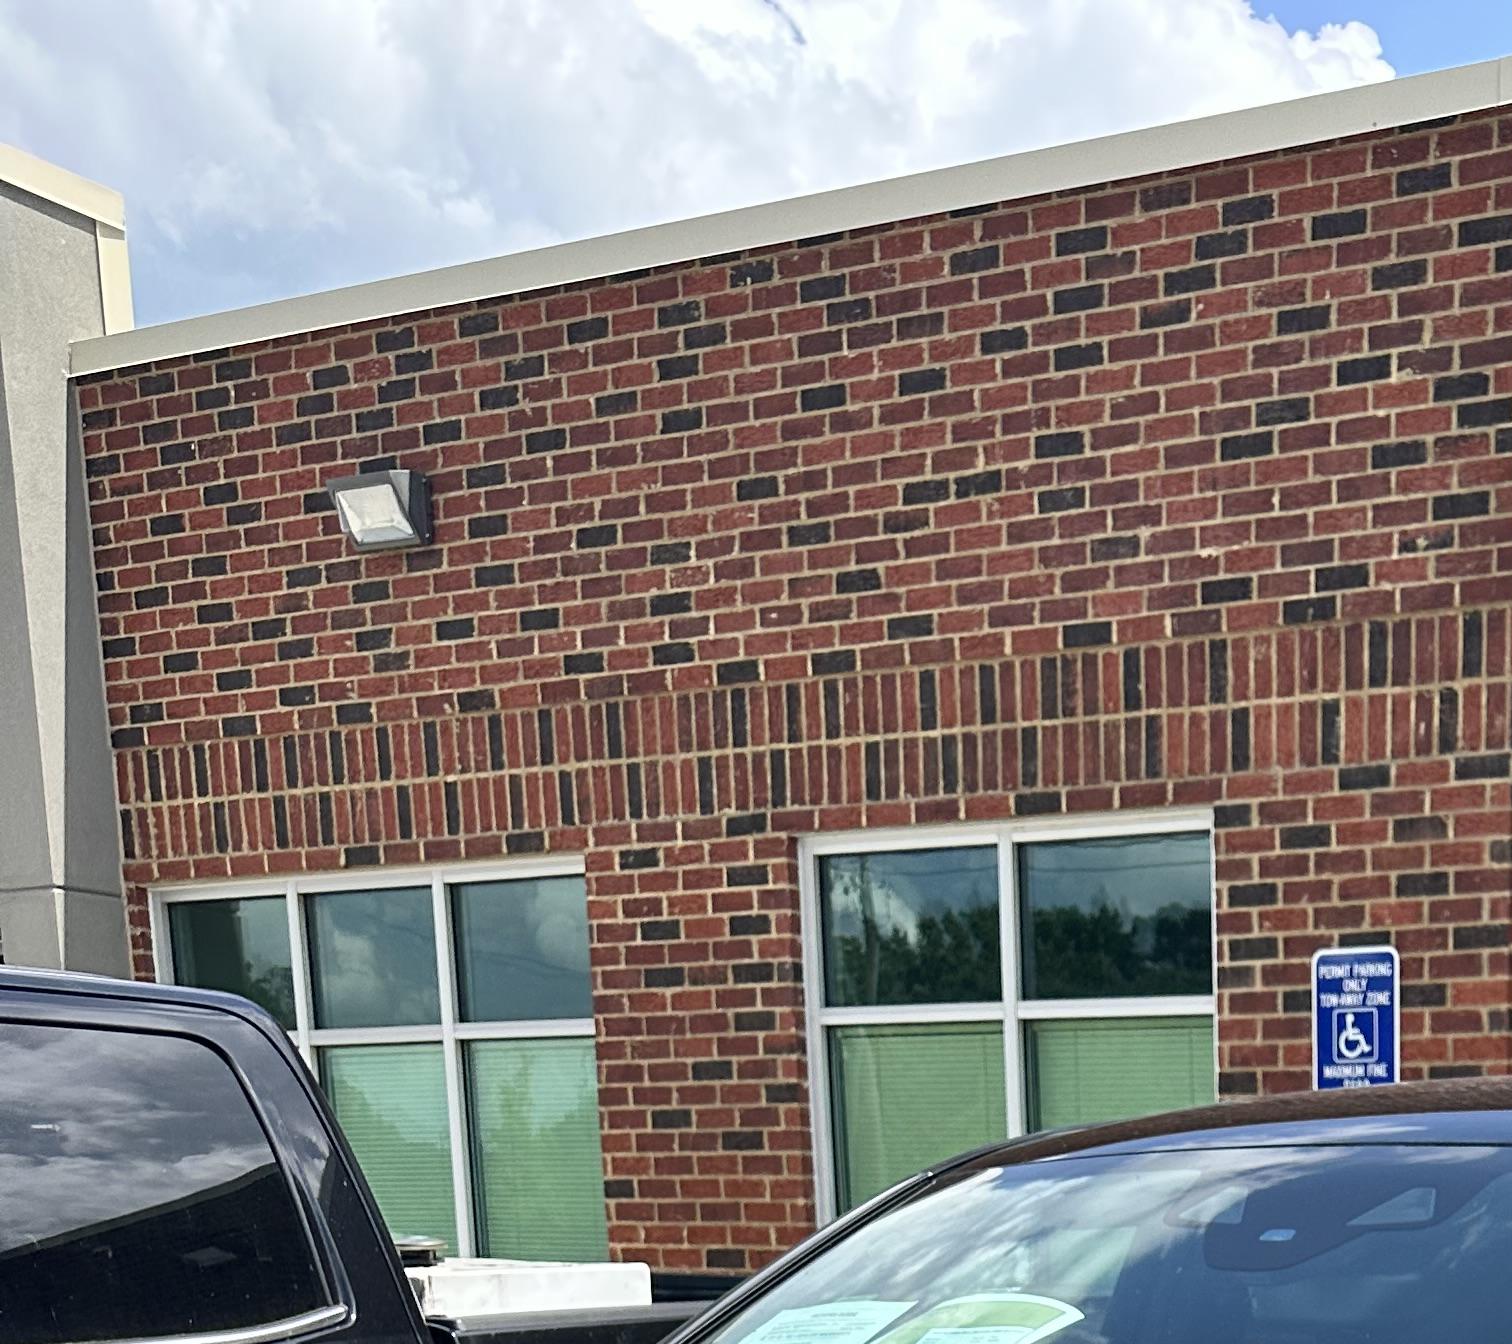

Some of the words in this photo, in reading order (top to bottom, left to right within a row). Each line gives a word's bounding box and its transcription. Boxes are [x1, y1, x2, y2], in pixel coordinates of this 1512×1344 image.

[1353, 962, 1392, 977] PARKING
[1342, 978, 1368, 992] ONLY
[1366, 991, 1391, 1006] ZONE
